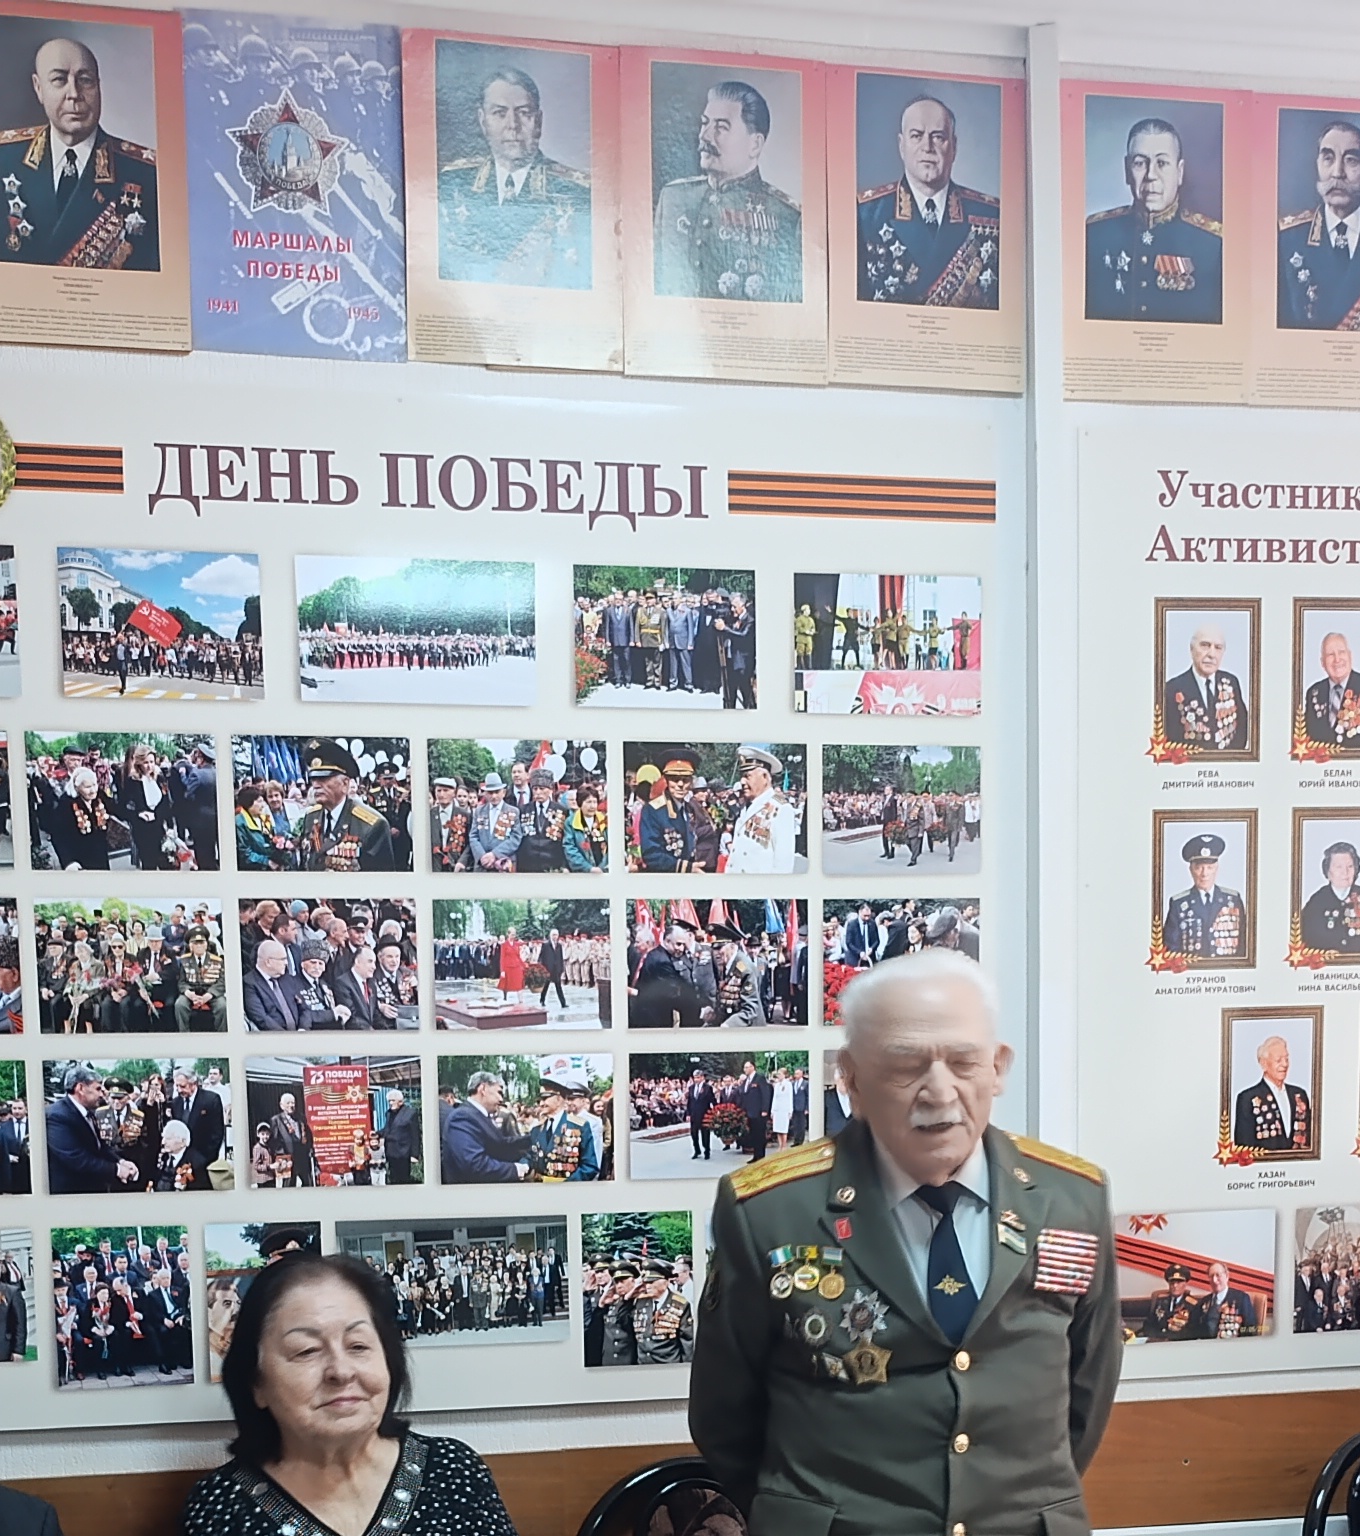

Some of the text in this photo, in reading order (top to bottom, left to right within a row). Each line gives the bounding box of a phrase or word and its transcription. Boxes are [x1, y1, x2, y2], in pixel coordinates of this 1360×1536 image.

[232, 229, 354, 254] МАРШАЛЫ
[246, 260, 341, 283] ПОБЕДЫ
[207, 297, 239, 313] 1941
[346, 306, 380, 322] 1945
[148, 442, 710, 533] ДЕНЬ ПОБЕДЫ
[1323, 769, 1352, 777] БЕЛАН
[1162, 780, 1254, 790] ДМИТРИЙ ИВАНОВИЧ
[1298, 779, 1325, 788] ЮРИЙ
[1185, 976, 1226, 984] ХУРАНОВ
[1155, 985, 1256, 995] АНАТОЛИЙ МУРАТОВИЧ
[1298, 984, 1322, 992] НИНА
[325, 1070, 362, 1078] ПОБЕДА!
[1257, 1171, 1286, 1179] ХАЗАН
[1227, 1179, 1315, 1190] БОРИС ГРИГОРЬЕВИЧ
